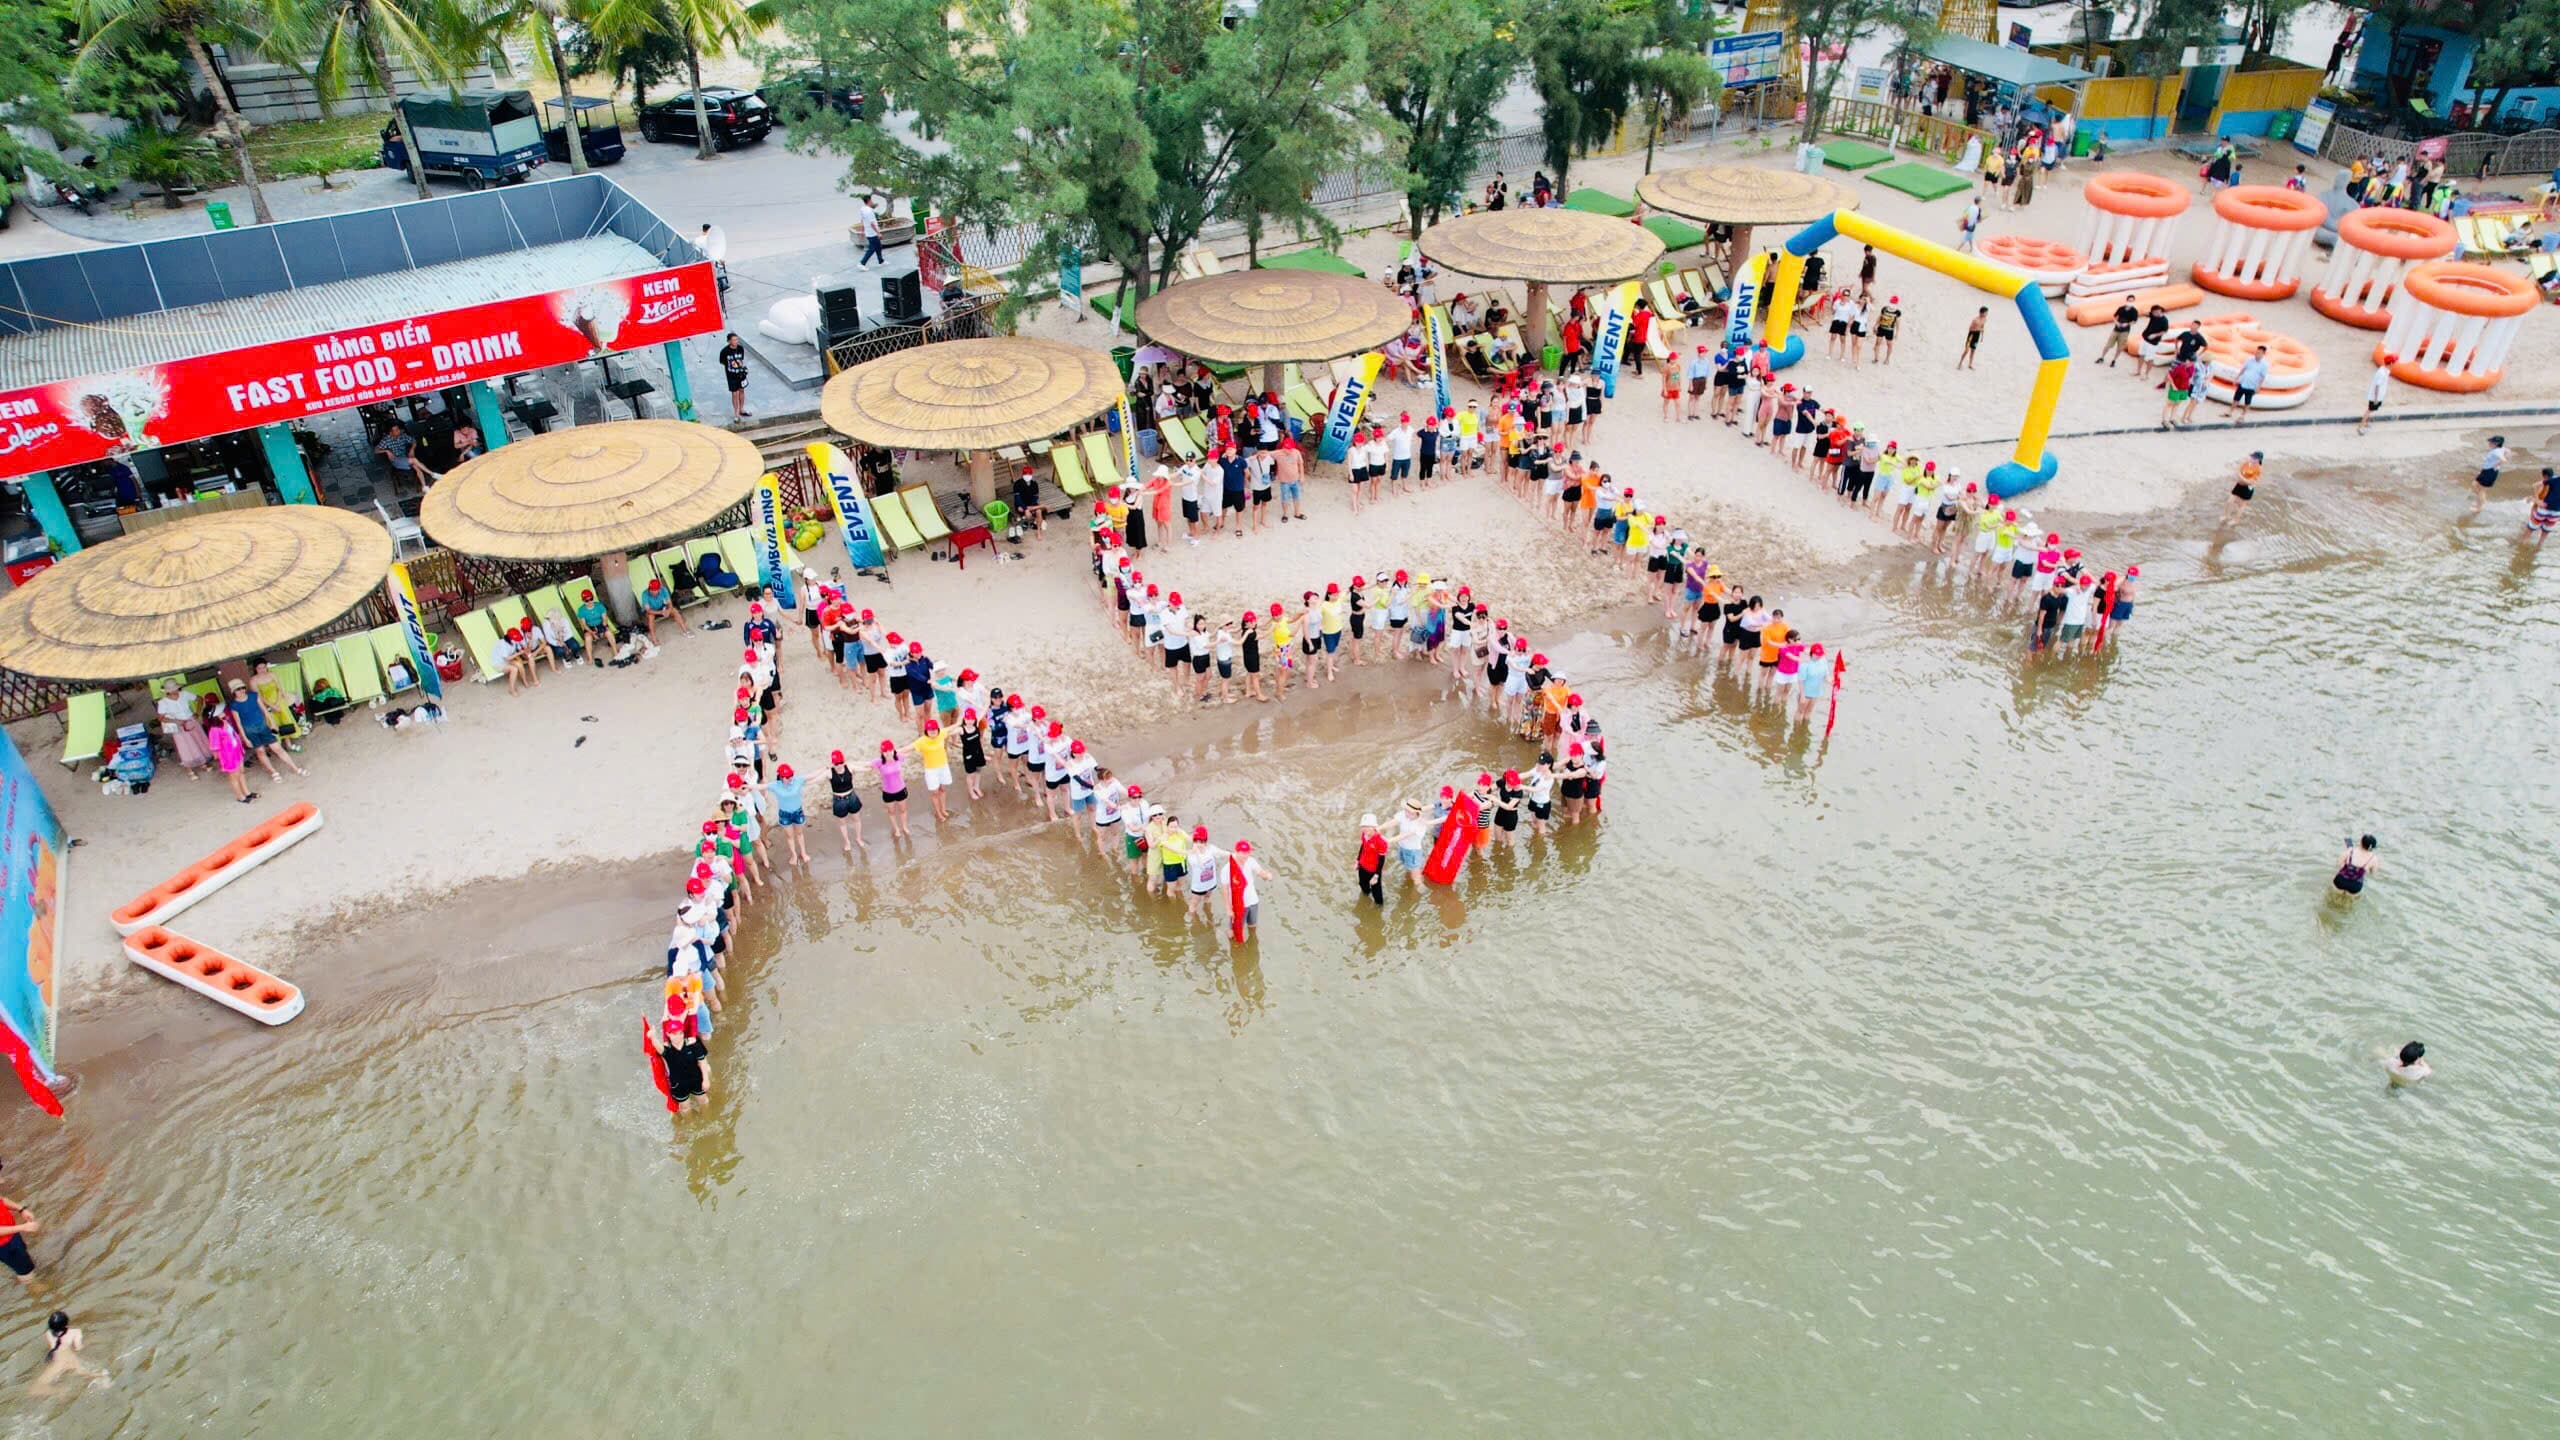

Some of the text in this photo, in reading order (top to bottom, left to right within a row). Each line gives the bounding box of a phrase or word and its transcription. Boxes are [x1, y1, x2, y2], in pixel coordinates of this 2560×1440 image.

[641, 293, 695, 320] Merino
[643, 277, 680, 297] KEM
[1732, 283, 1755, 343] EVENT
[314, 319, 431, 363] HẰNG BIỂN
[1599, 309, 1624, 374] EVENT
[227, 372, 306, 412] FAST
[315, 356, 397, 394] FOOD
[432, 331, 522, 371] DRINK
[324, 393, 355, 407] RESORT
[0, 398, 40, 420] EM
[1331, 376, 1364, 441] EVENT
[828, 473, 869, 541] EVENT
[400, 593, 433, 668] EVENT
